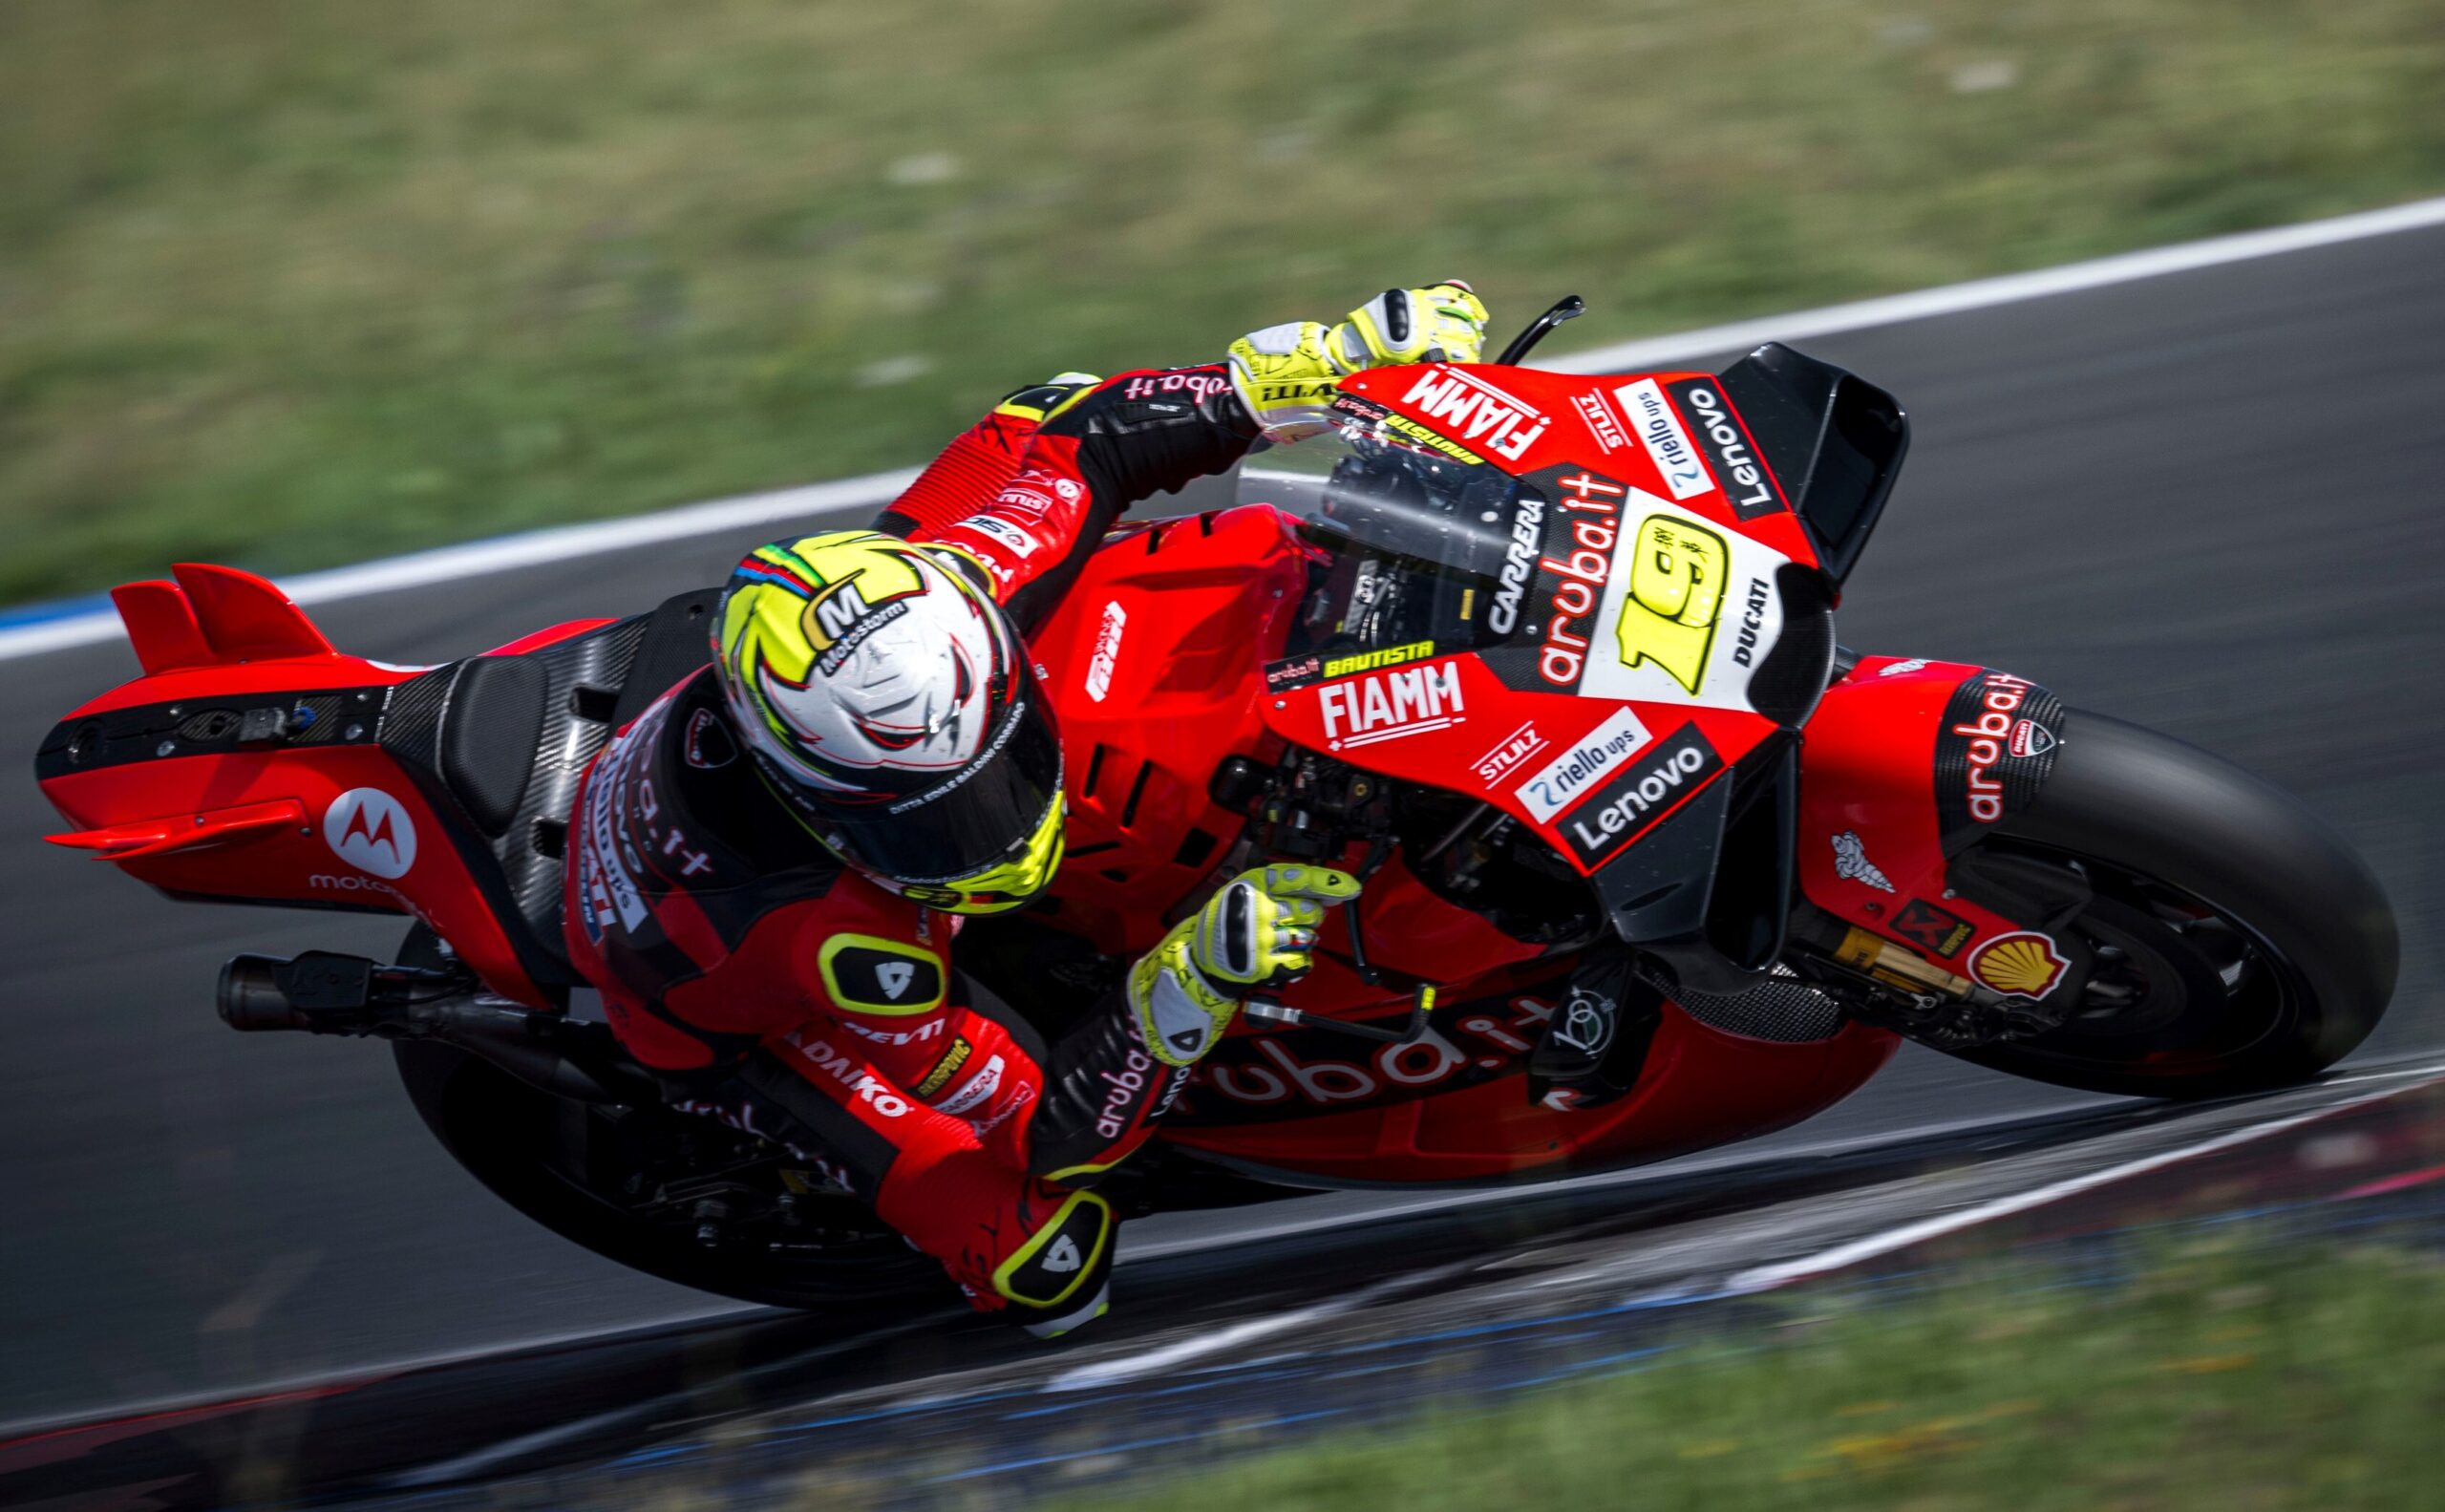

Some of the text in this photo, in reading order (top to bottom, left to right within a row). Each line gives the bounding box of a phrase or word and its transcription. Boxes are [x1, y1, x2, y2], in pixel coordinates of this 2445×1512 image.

[1386, 413, 1485, 466] BAUTISTA
[1400, 369, 1538, 461] FIAMM
[1581, 393, 1626, 449] STULZ
[1637, 392, 1690, 466] riello ups
[1690, 389, 1773, 507] Lenovo
[1489, 500, 1544, 635] CARRERA
[1539, 472, 1625, 688] aruba.it
[1616, 513, 1731, 697] 19
[815, 585, 871, 641] M
[821, 604, 905, 674] Motostorm
[1733, 578, 1770, 669] DUCATI
[1266, 658, 1320, 685] aruba.it
[1324, 641, 1434, 678] BAUTISTA
[1318, 661, 1464, 739] FIAMM
[1478, 729, 1541, 779] STULZ
[1554, 728, 1636, 793] riello ups
[1953, 672, 2035, 823] aruba.it
[1574, 747, 1705, 851] Lenovo
[803, 1034, 910, 1117] DAIKO
[1150, 1066, 1187, 1118] Leno
